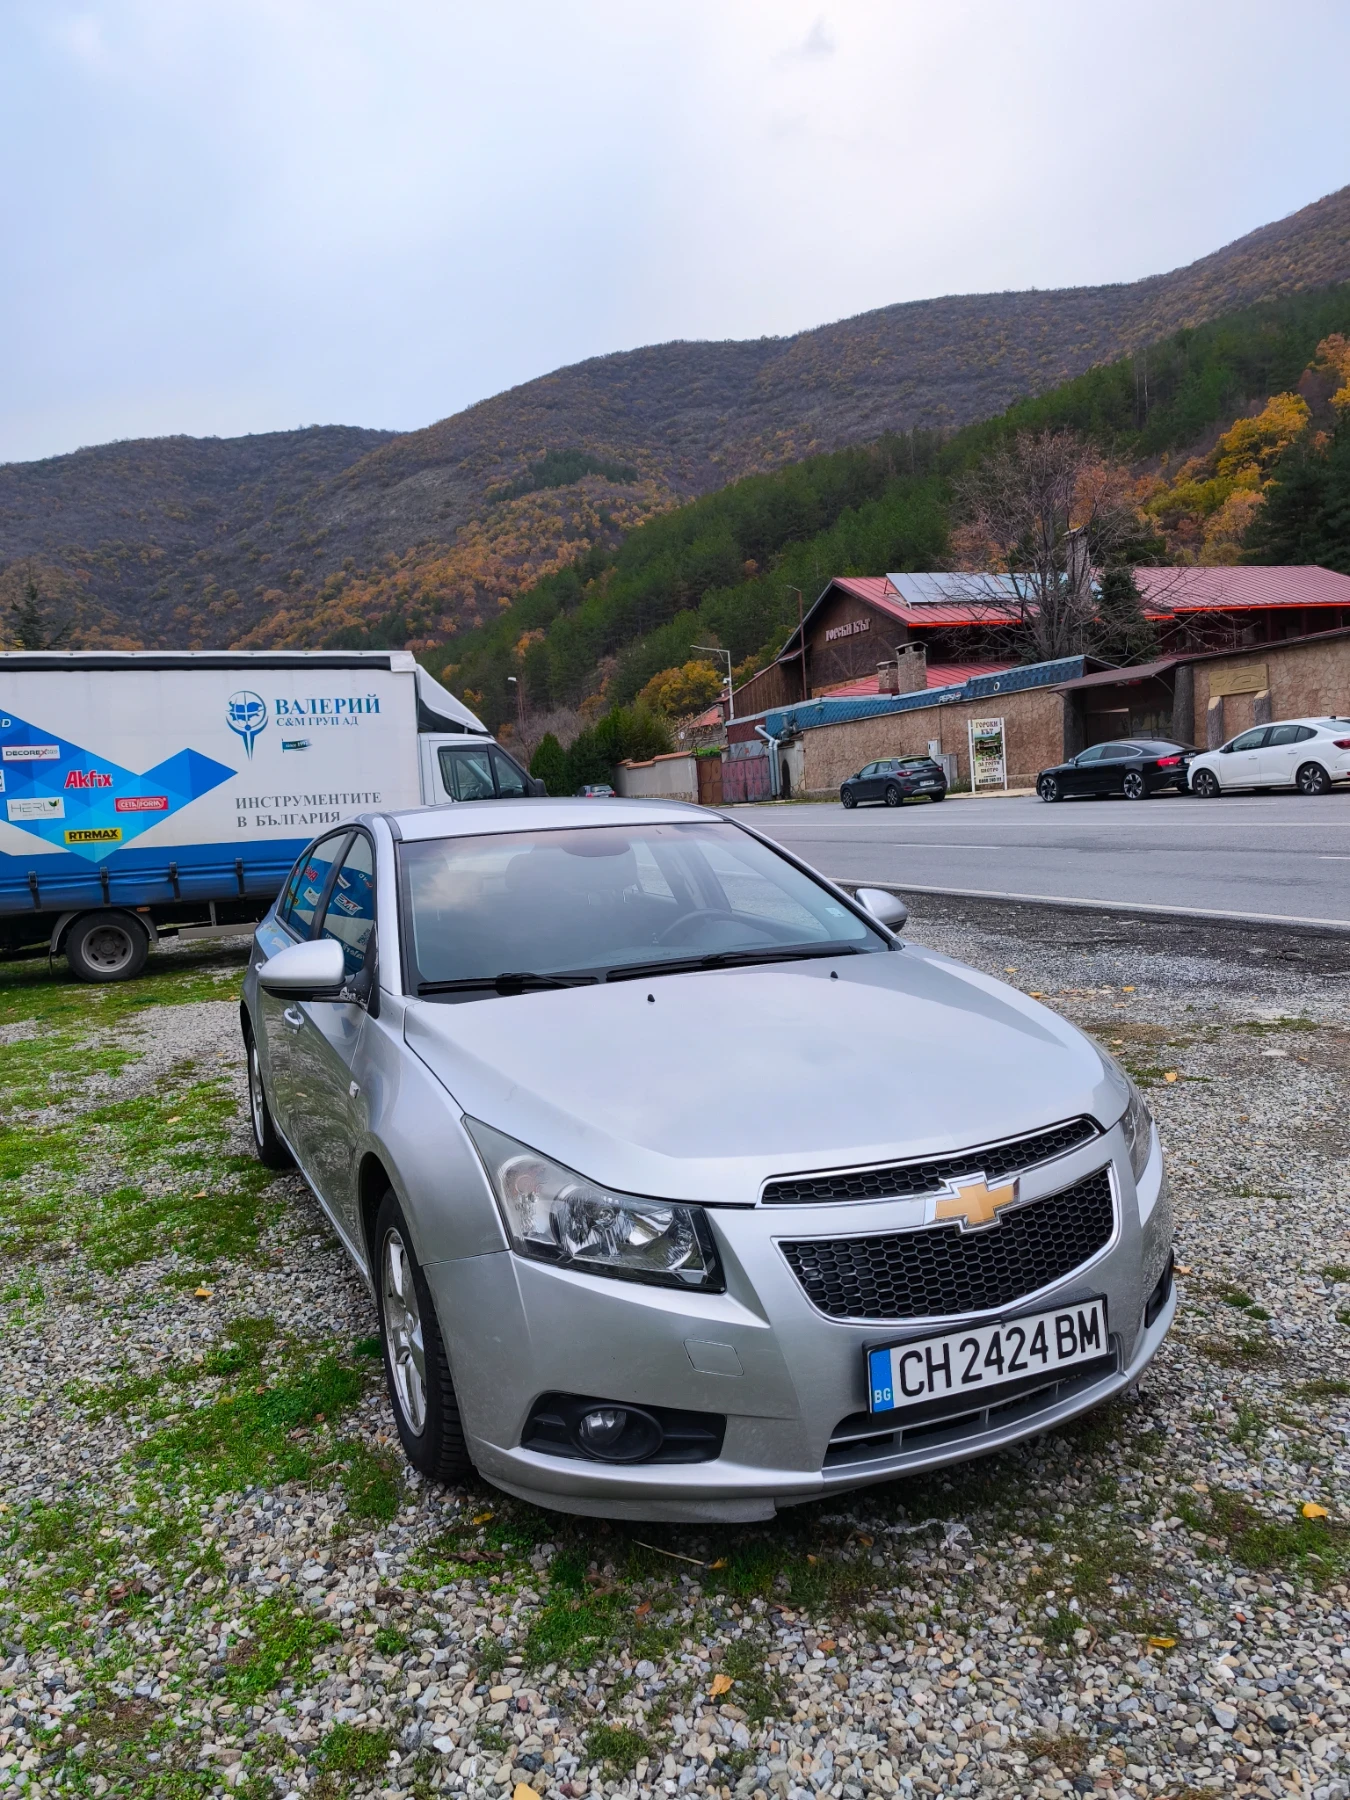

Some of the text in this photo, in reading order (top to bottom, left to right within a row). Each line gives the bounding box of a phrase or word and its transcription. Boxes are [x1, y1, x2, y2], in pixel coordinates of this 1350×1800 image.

[274, 693, 381, 715] ВАЛЕРИЙ
[308, 716, 339, 726] ГРУП
[342, 715, 360, 726] АД
[64, 770, 113, 789] Akfix
[235, 792, 382, 809] ИНСТРУМЕНТИТЕ
[237, 811, 340, 828] В БЪЛГАРИЯ
[68, 829, 118, 840] RTRMAX
[874, 1387, 891, 1403] BG
[959, 1320, 1049, 1385] 2424
[1055, 1306, 1101, 1360] BM
